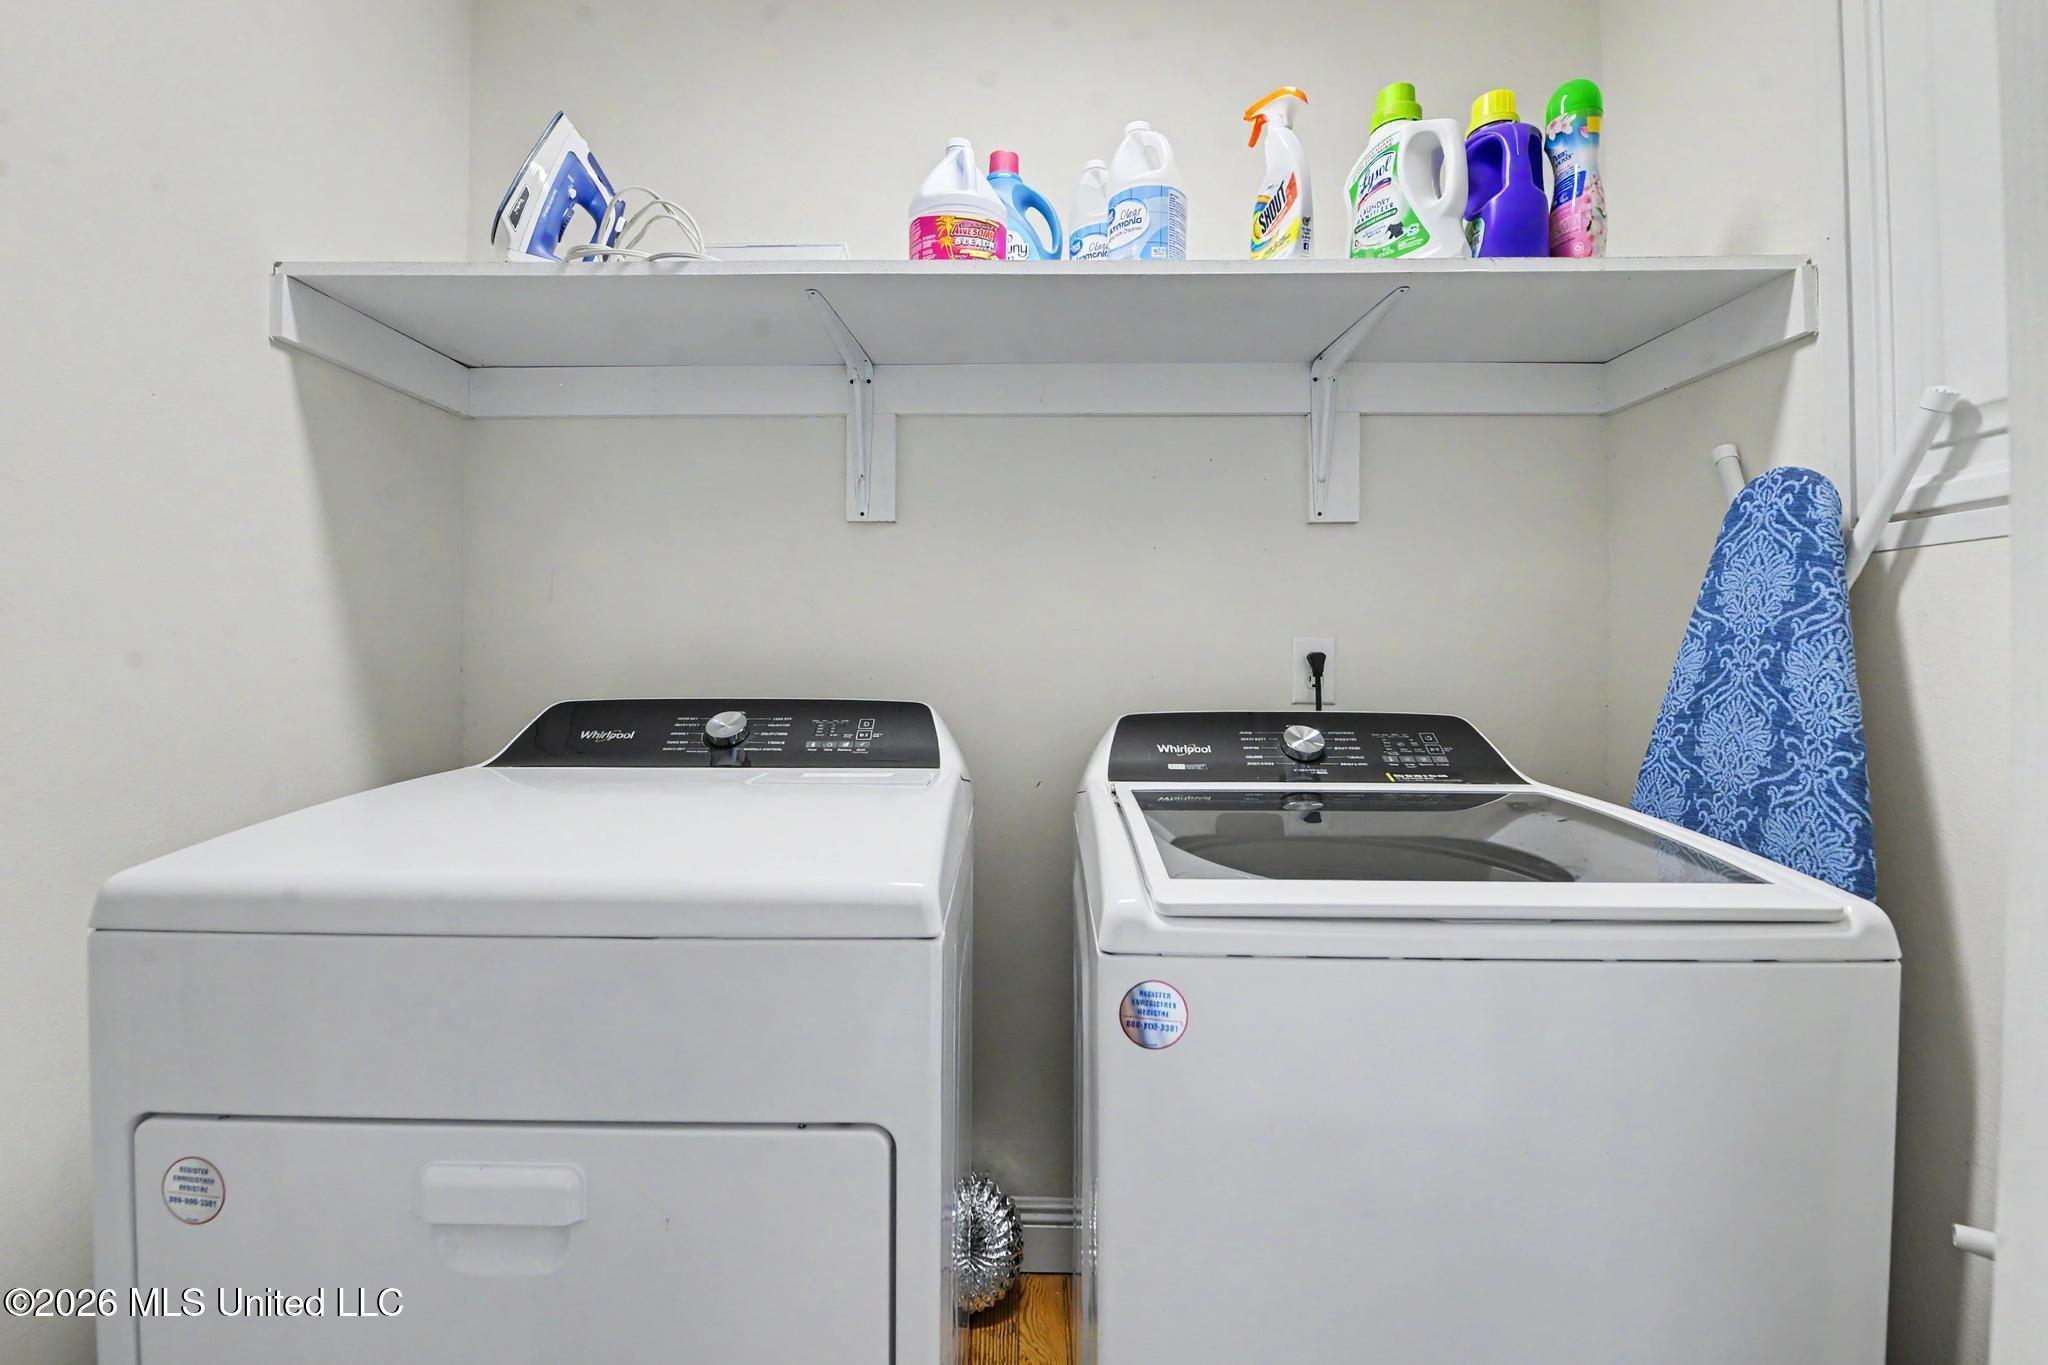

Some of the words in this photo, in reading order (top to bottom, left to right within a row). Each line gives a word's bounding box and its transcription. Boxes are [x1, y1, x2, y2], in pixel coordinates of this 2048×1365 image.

[1359, 155, 1393, 196] Lysol
[1258, 180, 1286, 235] SHOUT
[580, 729, 636, 743] Whirlpool
[1156, 743, 1212, 756] Whirlpool
